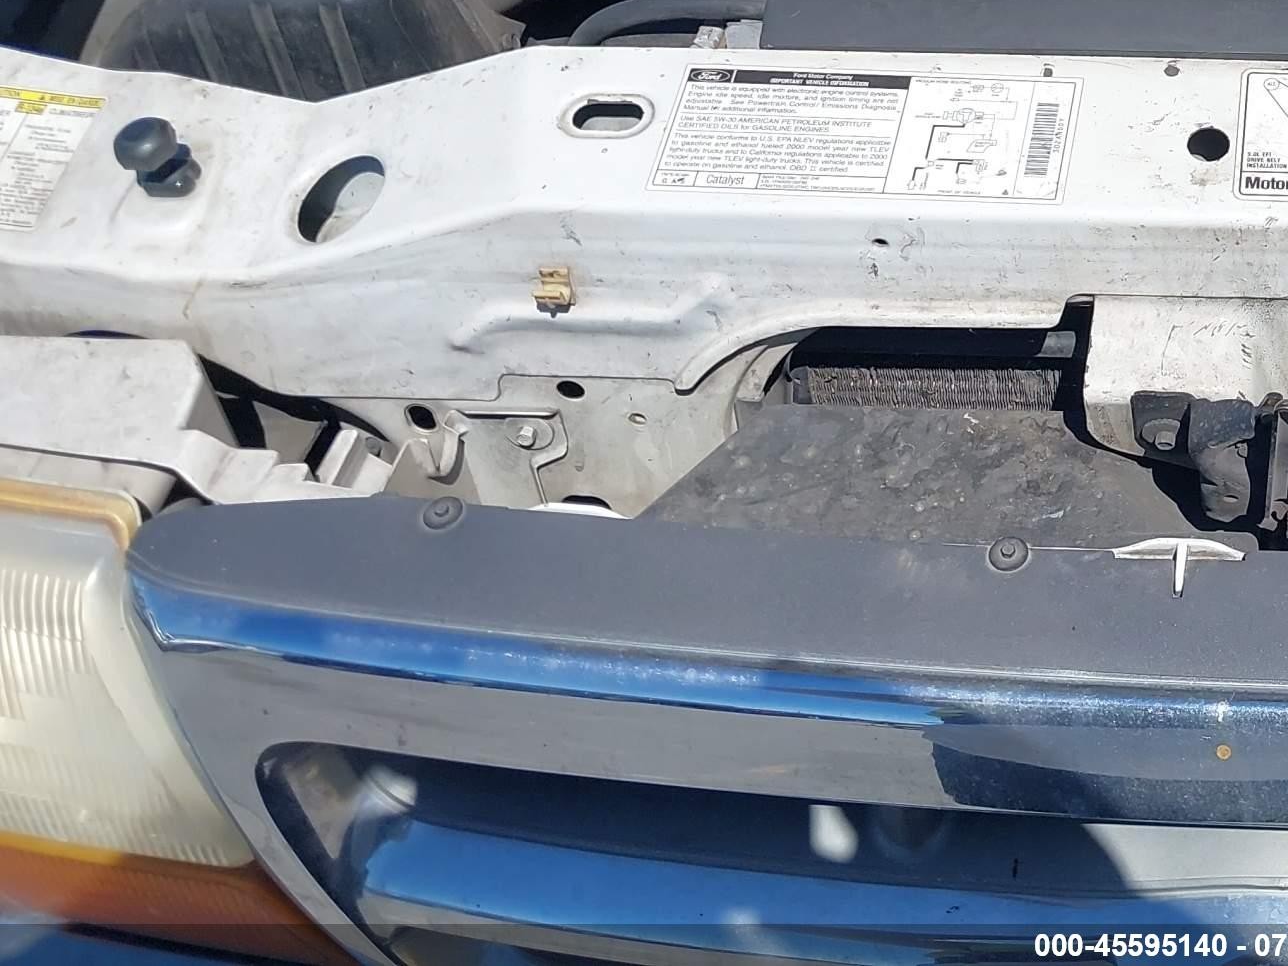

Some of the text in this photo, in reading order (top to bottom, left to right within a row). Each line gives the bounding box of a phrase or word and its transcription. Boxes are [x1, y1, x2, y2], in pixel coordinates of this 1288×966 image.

[698, 71, 722, 81] Ford
[780, 118, 830, 126] PETROLEUM
[707, 174, 744, 186] Catalyst
